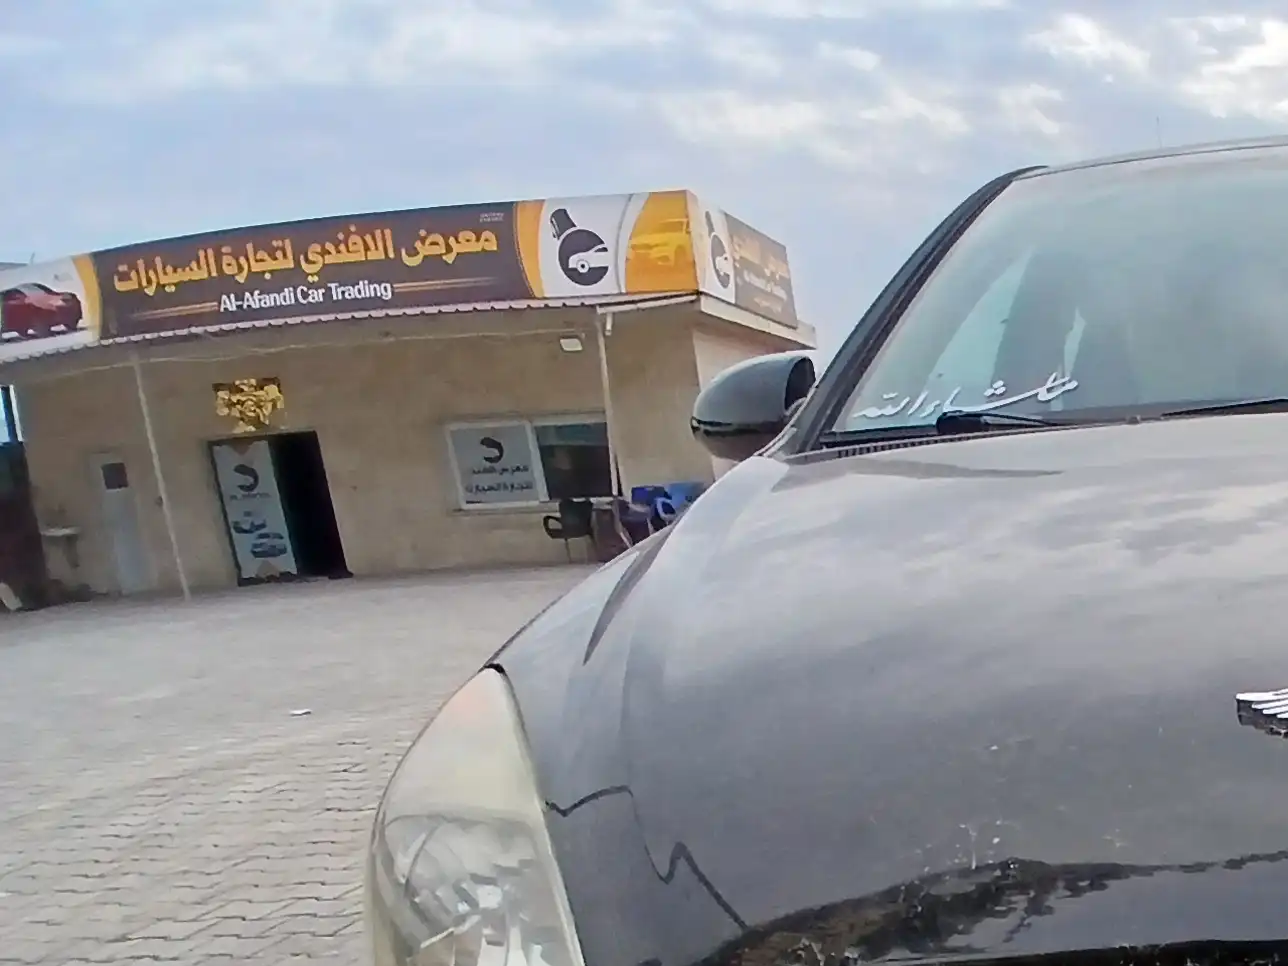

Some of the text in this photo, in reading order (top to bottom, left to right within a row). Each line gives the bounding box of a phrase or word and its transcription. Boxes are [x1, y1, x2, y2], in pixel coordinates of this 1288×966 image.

[113, 224, 498, 297] معرض الافندي لتجارة السيارات
[219, 279, 392, 313] Al-Afandi Car Trading
